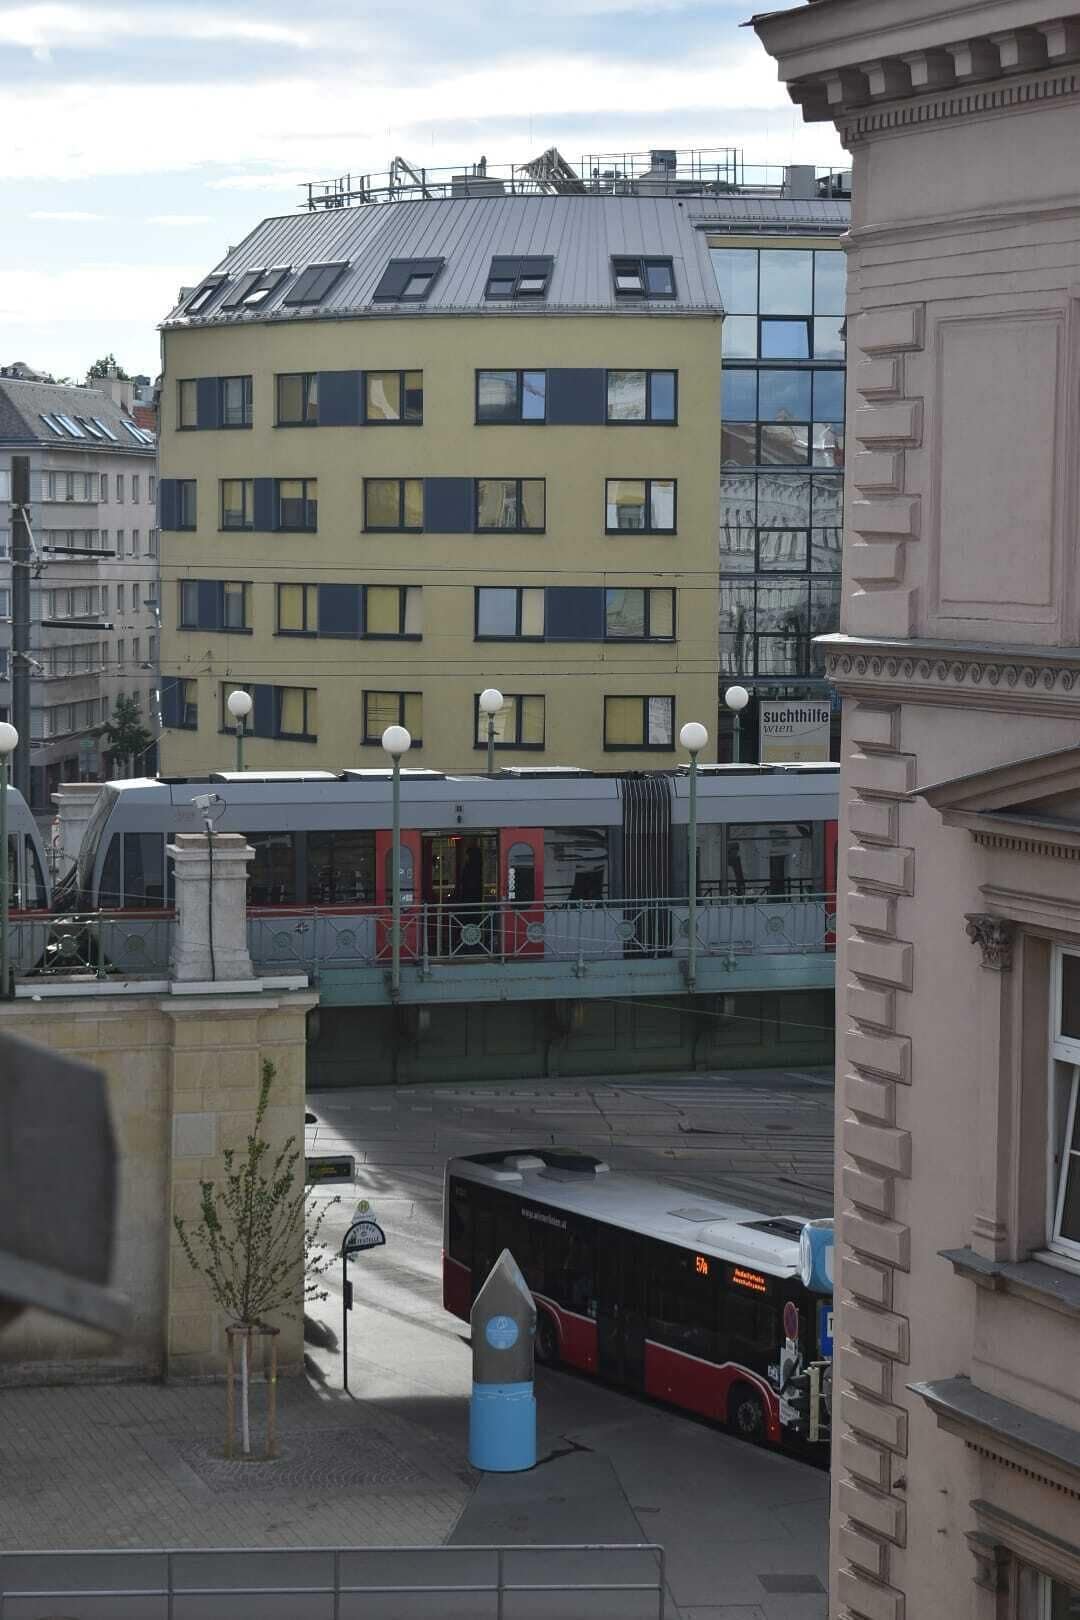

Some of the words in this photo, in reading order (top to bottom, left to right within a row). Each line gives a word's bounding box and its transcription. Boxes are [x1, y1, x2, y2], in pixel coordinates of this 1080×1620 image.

[763, 708, 829, 723] suchthilfe
[763, 725, 793, 733] wien
[696, 1255, 708, 1275] 57A
